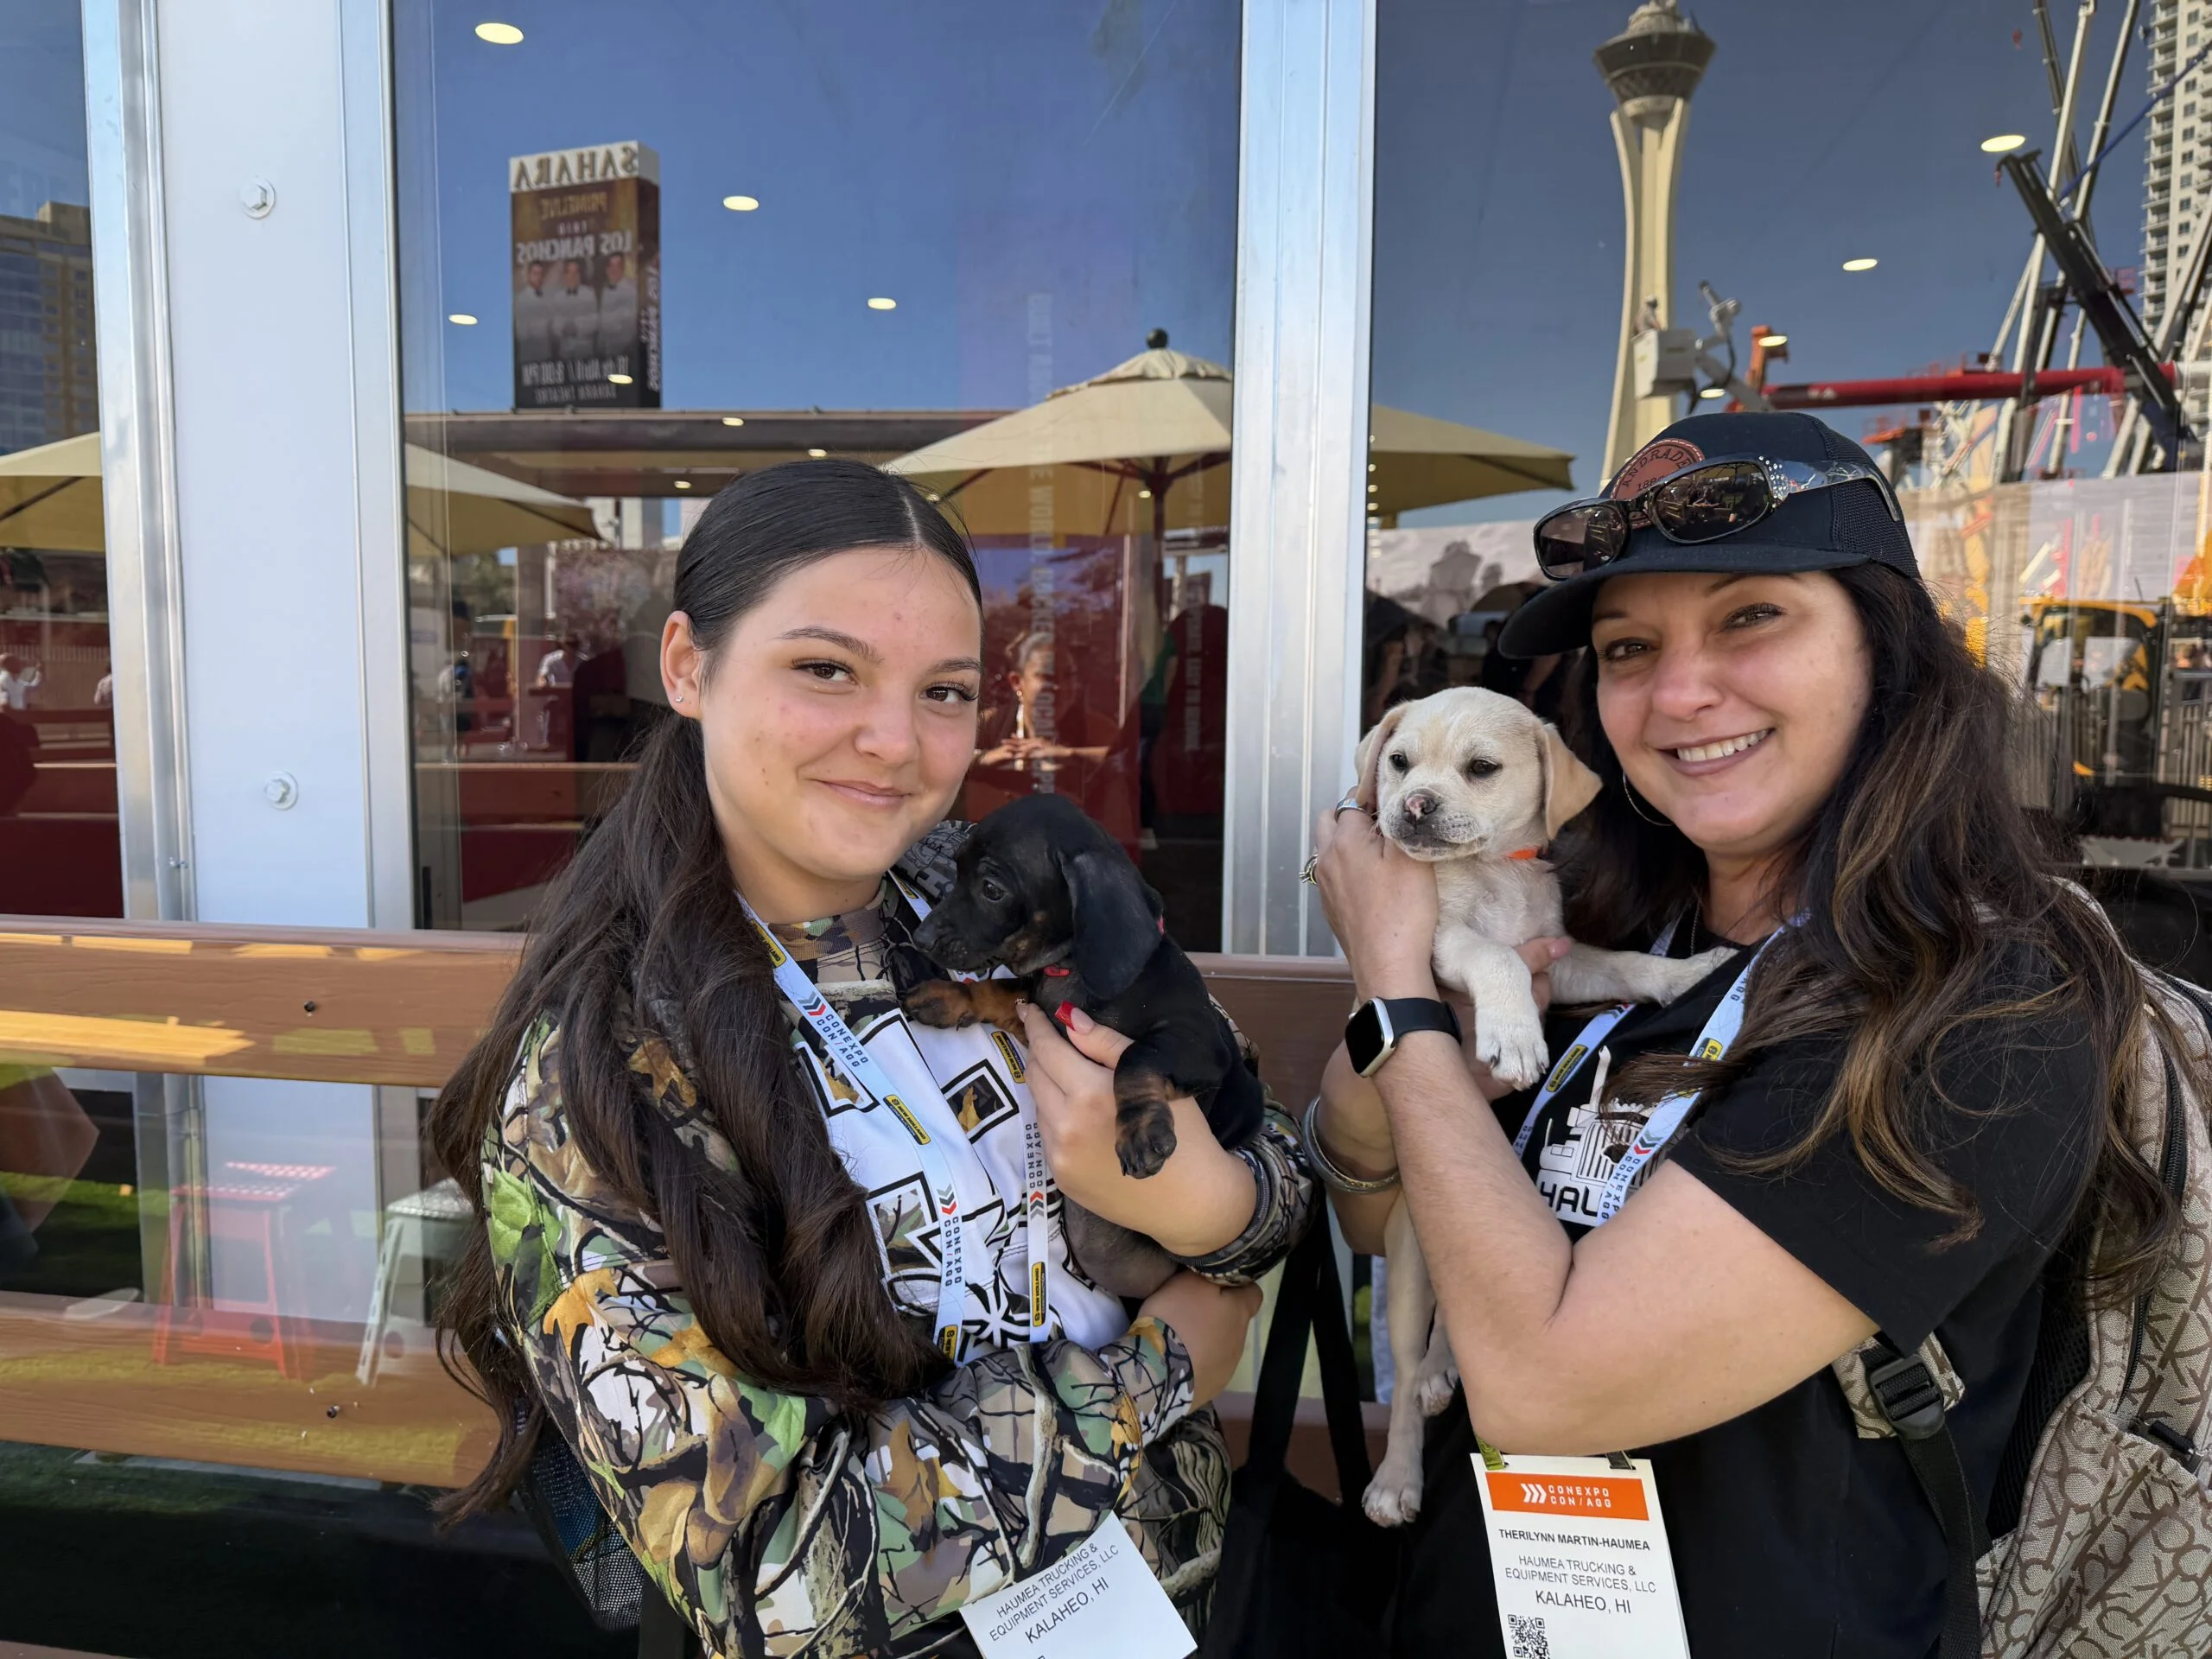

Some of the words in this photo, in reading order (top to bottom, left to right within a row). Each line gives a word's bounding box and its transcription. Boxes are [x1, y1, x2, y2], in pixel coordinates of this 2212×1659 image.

[1622, 448, 1692, 488] ANDRADE
[816, 1018, 861, 1068] CON/AGG
[826, 1014, 869, 1064] CONEXPO
[1025, 1123, 1036, 1189] CONEXPO
[1601, 1155, 1633, 1219] CON/AGG
[1611, 1158, 1641, 1211] CONEXP
[944, 1218, 954, 1287] CON/AGG
[951, 1216, 963, 1284] CONEXPO
[1548, 1484, 1610, 1497] CONEXPO
[1550, 1496, 1611, 1508] CON/AGG
[1498, 1529, 1555, 1543] THERILYNN
[1557, 1534, 1650, 1551] MARTIN-HAUMEA
[1518, 1554, 1565, 1569] HAUMEA
[1567, 1559, 1625, 1575] TRUCKING
[1628, 1566, 1637, 1576] &
[989, 1595, 1049, 1641] EQUIPMENT
[1050, 1562, 1102, 1599] SERVICES,
[1101, 1544, 1120, 1565] LLC
[996, 1580, 1040, 1618] HAUMEA
[1038, 1548, 1090, 1588] TRUCKING
[1088, 1542, 1098, 1553] &
[1505, 1567, 1568, 1584] EQUIPMENT
[1572, 1573, 1632, 1592] SERVICES,
[1634, 1581, 1656, 1593] LLC
[1535, 1590, 1612, 1615] KALAHEO,
[1615, 1599, 1631, 1614] HI
[1025, 1591, 1095, 1643] KALAHEO,
[1091, 1576, 1109, 1596] HI
